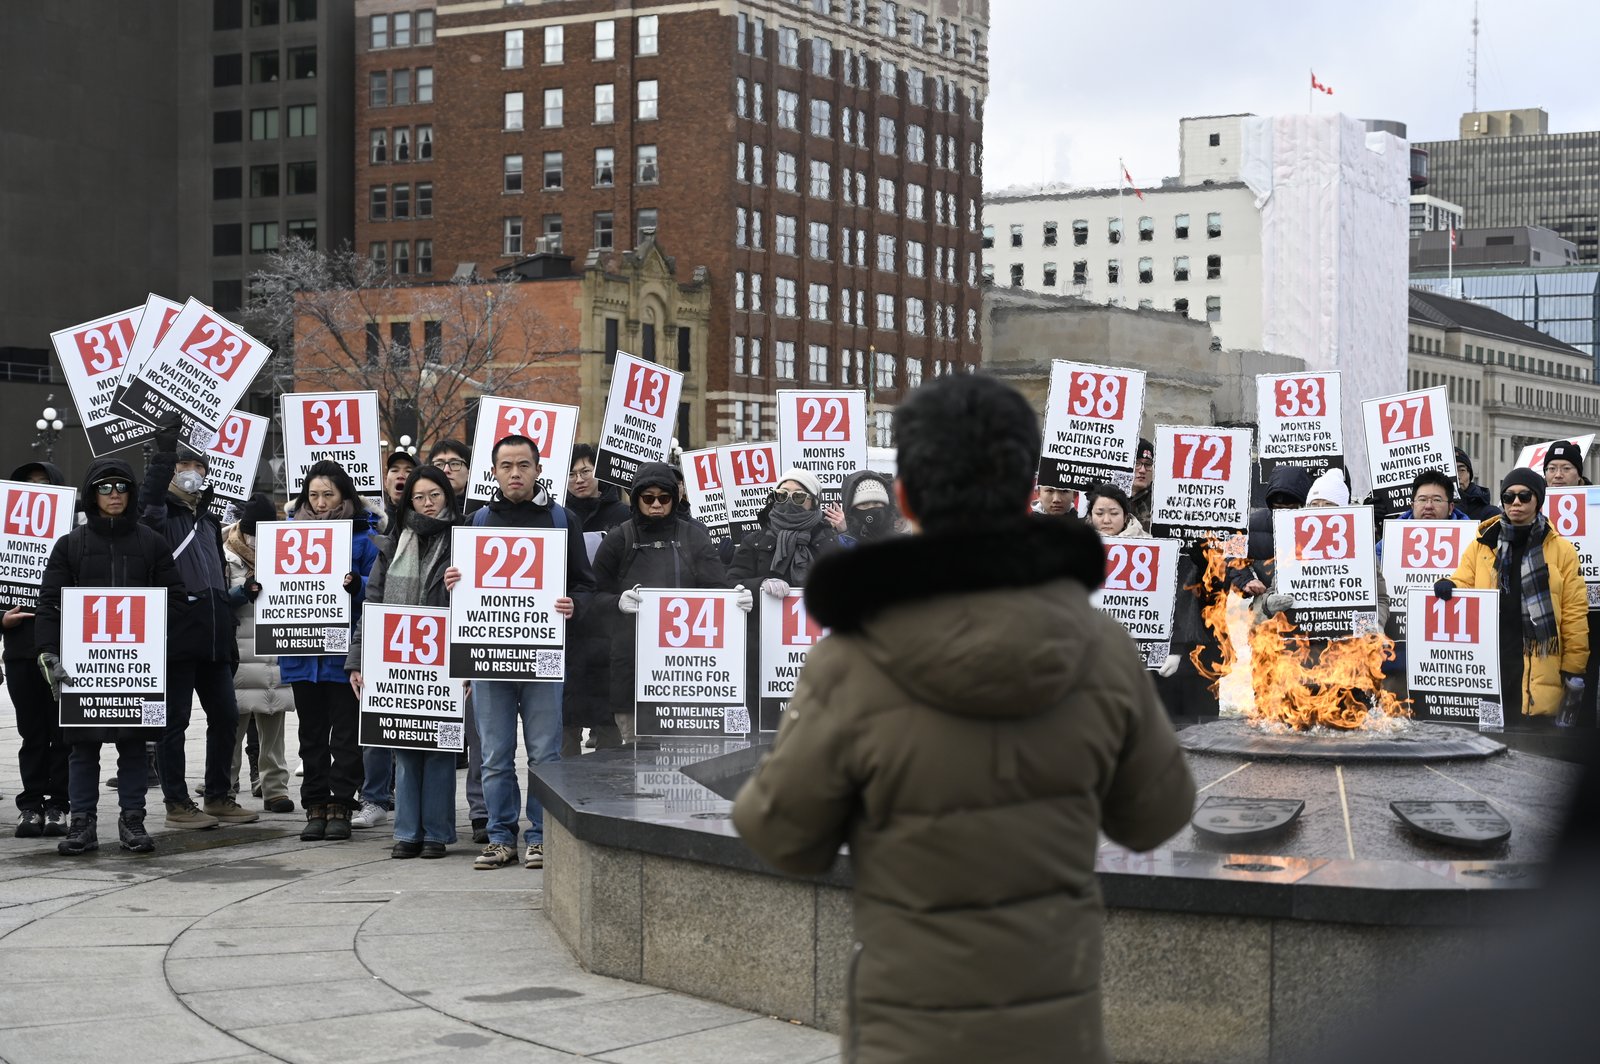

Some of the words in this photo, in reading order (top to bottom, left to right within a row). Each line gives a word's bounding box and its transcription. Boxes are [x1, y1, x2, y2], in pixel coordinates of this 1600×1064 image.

[85, 322, 129, 371] 31
[186, 321, 242, 374] 23
[174, 359, 218, 390] MONTHS
[158, 363, 200, 394] WAITING
[198, 388, 222, 408] FOR
[630, 368, 663, 415] 13
[145, 388, 159, 401] NO
[147, 369, 169, 388] IRCC
[166, 382, 221, 423] RESPONSE
[1073, 373, 1120, 418] 38
[1279, 379, 1320, 416] 33
[142, 399, 156, 412] NO
[310, 400, 354, 444] 31
[624, 415, 656, 433] MONTHS
[803, 399, 844, 440] 22
[1386, 398, 1424, 442] 27
[104, 422, 116, 435] NO
[1070, 420, 1114, 434] MONTHS
[1280, 422, 1320, 431] MONTHS
[112, 431, 125, 444] NO
[614, 425, 646, 443] WAITING
[647, 434, 662, 448] FOR
[1057, 431, 1100, 446] WAITING
[1104, 437, 1124, 448] FOR
[1271, 433, 1310, 442] WAITING
[1313, 432, 1331, 441] FOR
[607, 436, 624, 450] IRCC
[1287, 443, 1337, 453] RESPONSE
[803, 448, 845, 458] MONTHS
[1049, 444, 1072, 455] IRCC
[1073, 448, 1129, 462] RESPONSE
[1389, 442, 1430, 458] MONTHS
[611, 457, 620, 467] NO
[1180, 436, 1225, 479] 72
[1381, 456, 1421, 472] WAITING
[1423, 452, 1442, 464] FOR
[347, 463, 368, 473] FOR
[737, 450, 769, 484] 19
[793, 461, 834, 470] WAITING
[837, 461, 856, 470] FOR
[1057, 463, 1069, 472] NO
[224, 472, 242, 483] FOR
[611, 468, 621, 478] NO
[701, 455, 721, 489] 1
[1376, 472, 1398, 484] IRCC
[1059, 474, 1071, 483] NO
[1178, 484, 1224, 495] MONTHS
[1388, 489, 1399, 498] NO
[705, 493, 723, 502] MON
[1214, 498, 1236, 509] FOR
[1392, 499, 1404, 508] NO
[10, 492, 51, 536] 40
[699, 503, 726, 513] WAITIN
[732, 510, 749, 518] IRCC
[1302, 516, 1347, 559] 23
[7, 540, 47, 554] MONTHS
[280, 530, 326, 573] 35
[1407, 528, 1453, 568] 35
[482, 538, 536, 588] 22
[1578, 555, 1592, 564] OR
[1105, 545, 1152, 590] 28
[1302, 565, 1348, 576] MONTHS
[280, 581, 325, 591] MONTHS
[1291, 578, 1336, 589] WAITING
[1340, 577, 1362, 587] FOR
[9, 586, 39, 597] TIMELIN
[1310, 590, 1369, 601] RESPONSE
[269, 594, 313, 605] WAITING
[316, 594, 337, 604] FOR
[481, 597, 534, 608] MONTHS
[1103, 595, 1149, 607] MONTHS
[262, 608, 285, 618] IRCC
[287, 607, 343, 618] RESPONSE
[467, 611, 520, 623] WAITING
[524, 612, 548, 624] FOR
[1139, 610, 1159, 621] FOR
[1295, 612, 1309, 622] NO
[91, 597, 136, 642] 11
[665, 598, 718, 647] 34
[792, 598, 831, 644] 1
[1433, 598, 1471, 642] 11
[272, 628, 284, 636] NO
[286, 628, 326, 637] TIMELINE
[459, 626, 486, 637] IRCC
[489, 627, 556, 639] RESPONSE
[1300, 623, 1312, 632] NO
[276, 639, 288, 648] NO
[390, 615, 438, 664] 43
[89, 650, 137, 660] MONTHS
[471, 648, 485, 658] NO
[488, 649, 537, 660] TIMELINE
[1431, 649, 1474, 660] MONTHS
[475, 661, 490, 670] NO
[665, 656, 716, 667] MONTHS
[77, 663, 124, 674] WAITING
[128, 664, 150, 674] FOR
[1420, 662, 1462, 674] WAITING
[1466, 664, 1485, 674] FOR
[97, 677, 157, 687] RESPONSE
[389, 670, 437, 683] MONTHS
[652, 670, 702, 682] WAITING
[706, 671, 730, 682] FOR
[768, 681, 794, 692] IRCC
[1414, 676, 1436, 686] IRCC
[1438, 676, 1492, 689] RESPONSE
[376, 683, 424, 696] WAITING
[428, 686, 450, 697] FOR
[644, 685, 670, 695] IRCC
[673, 686, 737, 697] RESPONSE
[80, 697, 94, 706] NO
[369, 697, 394, 708] IRCC
[396, 699, 456, 712] RESPONSE
[1425, 695, 1436, 704] NO
[84, 708, 97, 717] NO
[100, 708, 141, 717] RESULTS
[656, 706, 670, 716] NO
[672, 707, 724, 717] TIMELINES
[1429, 706, 1440, 716] NO
[380, 717, 393, 726] NO
[660, 719, 674, 728] NO
[677, 720, 719, 729] RESULTS
[384, 729, 397, 738] NO
